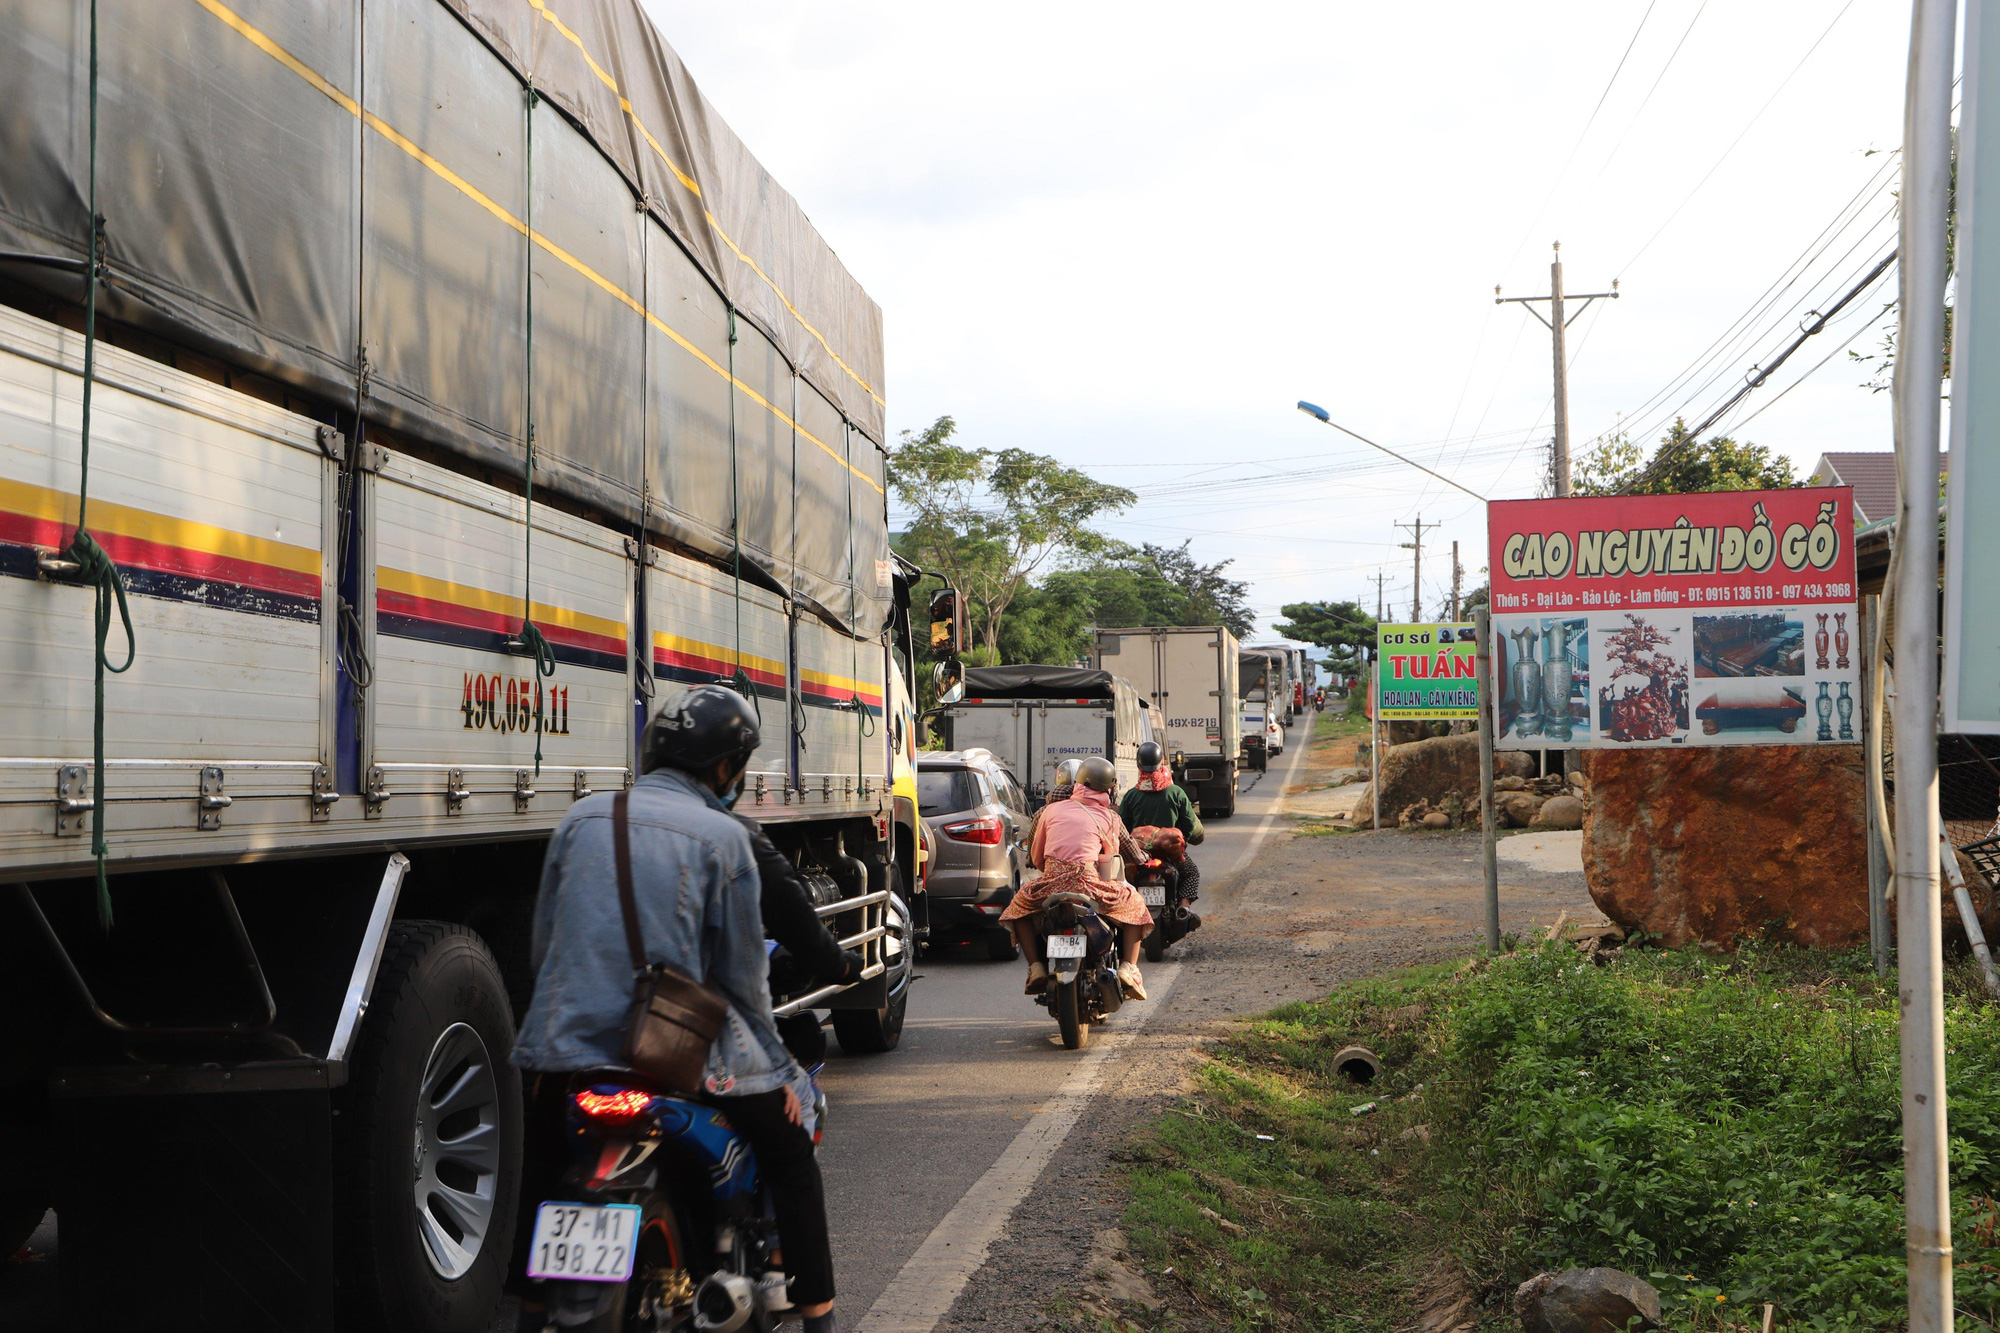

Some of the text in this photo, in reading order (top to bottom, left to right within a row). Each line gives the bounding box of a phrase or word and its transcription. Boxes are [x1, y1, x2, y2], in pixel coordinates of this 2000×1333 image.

[1503, 499, 1840, 580] CAO NGUYÊN ĐỒ GỖ
[1496, 593, 1519, 607] Thôn
[1522, 593, 1528, 606] 5
[1537, 592, 1553, 609] Đại
[1555, 591, 1573, 606] Lào
[1582, 589, 1601, 605] Bảo
[1604, 590, 1621, 607] Lộc
[1630, 589, 1651, 603] Lâm
[1654, 587, 1679, 604] Đồng
[1688, 587, 1703, 601] ĐT:
[1706, 587, 1730, 601] 0915
[1733, 586, 1751, 600] 136
[1754, 585, 1773, 599] 518
[1782, 585, 1801, 599] 097
[1804, 584, 1823, 598] 434
[1825, 583, 1850, 597] 3968
[1388, 647, 1477, 679] TUẤN
[1384, 691, 1402, 706] HOA
[1404, 691, 1421, 706] LAN
[1428, 688, 1446, 706] CÂY
[541, 1242, 625, 1275] 198.22
